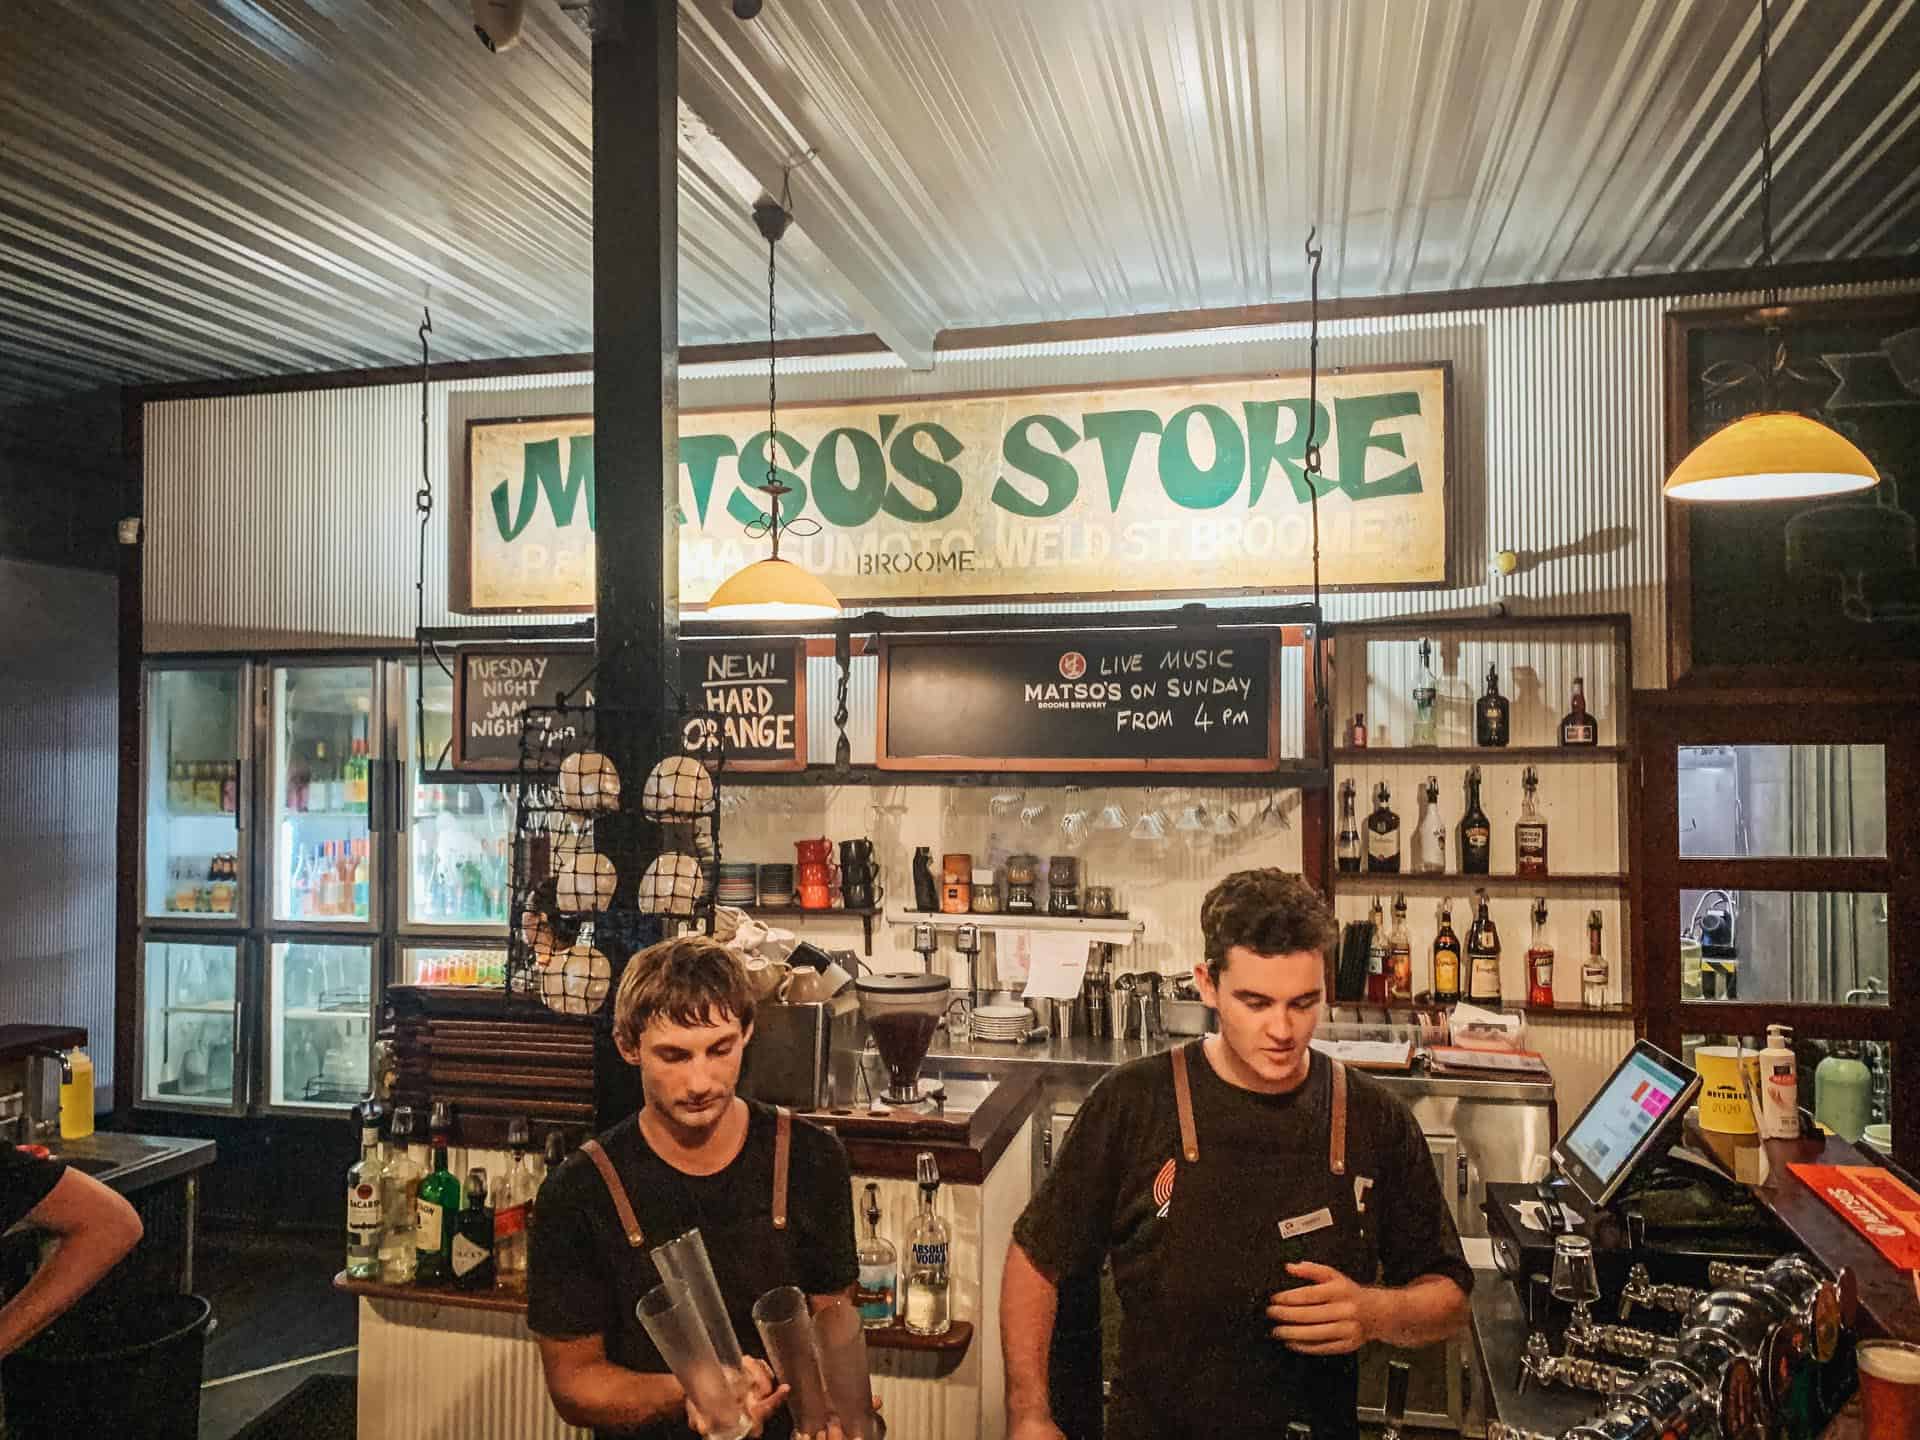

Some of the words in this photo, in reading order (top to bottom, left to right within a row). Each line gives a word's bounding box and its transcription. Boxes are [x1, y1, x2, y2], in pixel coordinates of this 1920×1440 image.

[490, 414, 964, 542] MTSO'S
[992, 391, 1423, 517] STORE
[857, 550, 976, 575] BROOME
[468, 657, 548, 680] TUESDAY
[708, 652, 775, 680] NEW!
[1100, 653, 1143, 676] LIVE
[1160, 649, 1233, 669] MUSIC
[483, 679, 539, 697] NIGHT
[1024, 681, 1121, 702] MATSO'S
[1130, 682, 1156, 699] ON
[1168, 676, 1251, 700] SUNDAY
[486, 700, 527, 718] JAM
[706, 686, 773, 716] HARD
[1117, 709, 1173, 732] FROM
[1194, 702, 1214, 733] 4
[684, 714, 794, 752] ORANGE
[912, 1242, 949, 1253] ABSOLUT
[916, 1254, 946, 1265] VODKA
